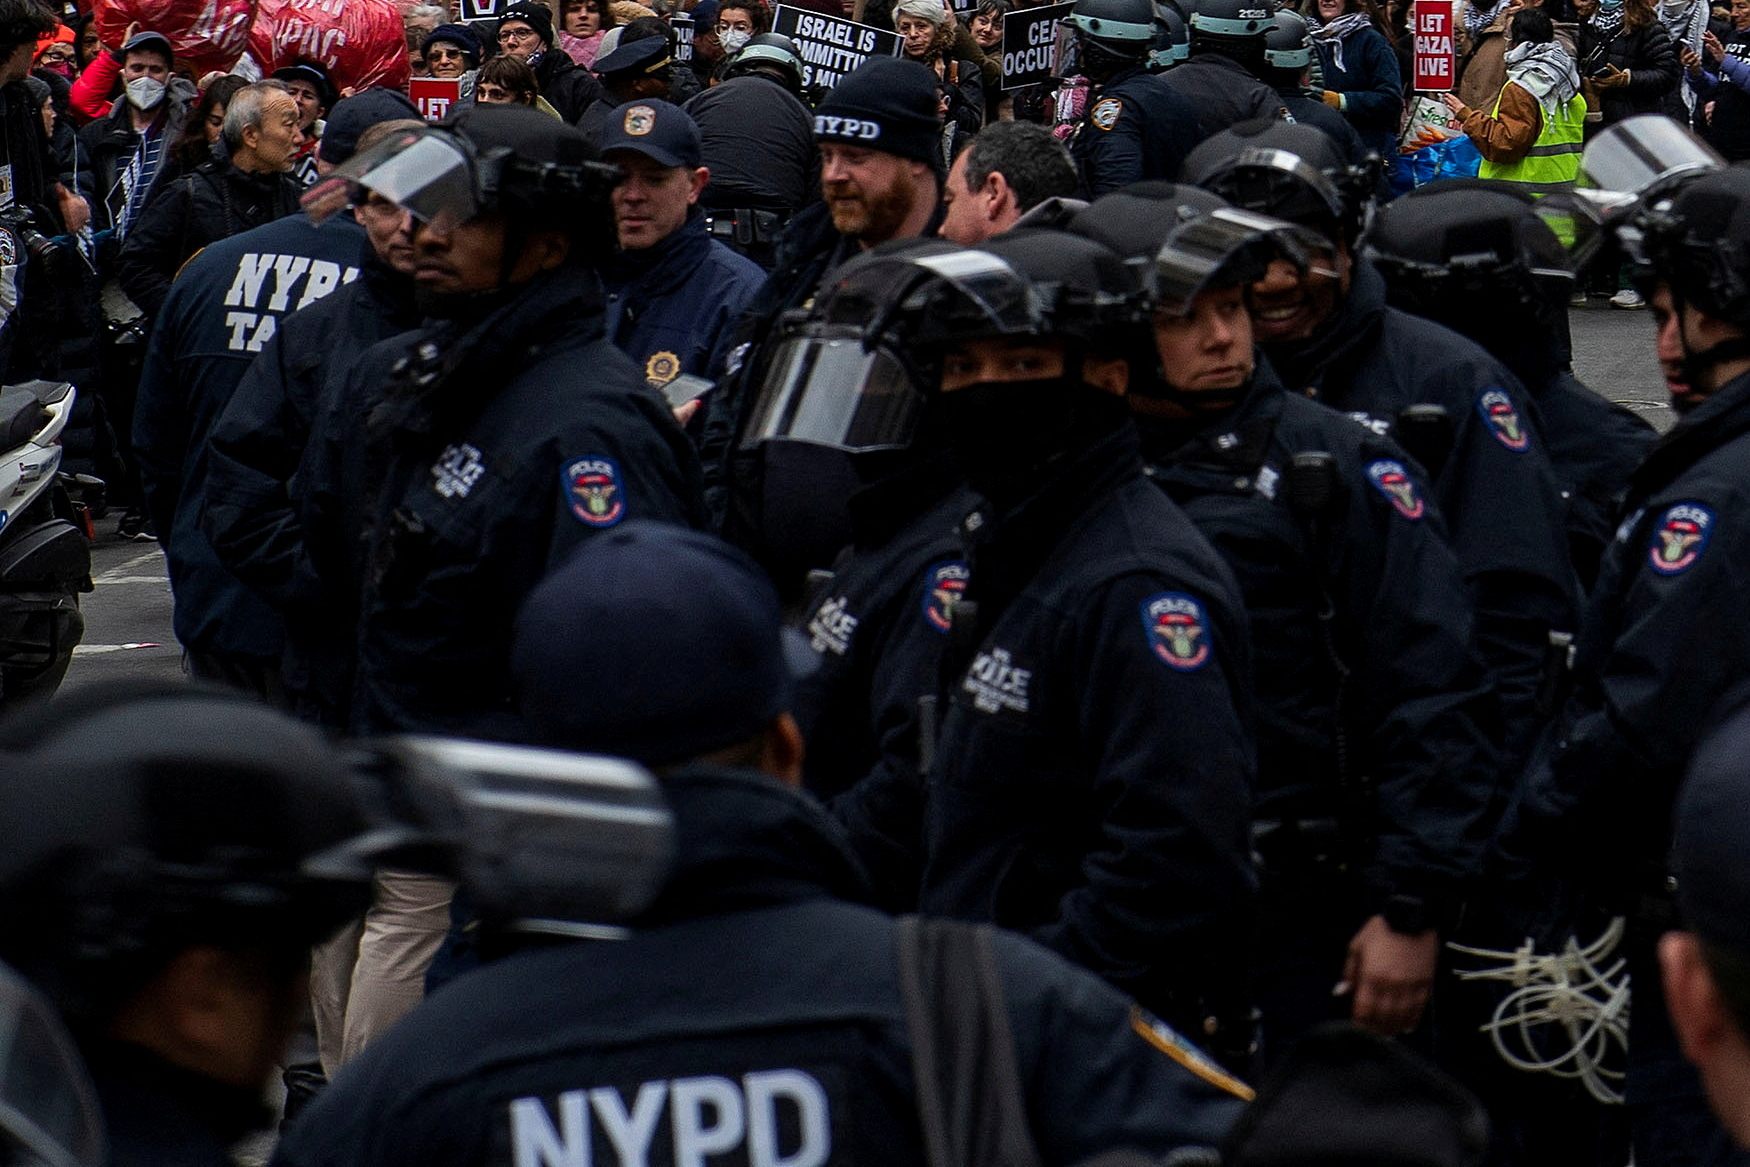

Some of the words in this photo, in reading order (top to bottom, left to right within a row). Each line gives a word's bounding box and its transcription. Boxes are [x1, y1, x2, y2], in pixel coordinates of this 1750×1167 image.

[795, 14, 855, 48] ISRAEL
[858, 29, 876, 52] IS
[1421, 14, 1446, 33] LET
[1416, 36, 1452, 54] GAZA
[1418, 58, 1449, 76] LIVE
[417, 97, 449, 120] LET
[223, 253, 360, 312] NYP
[509, 1067, 833, 1167] NYPD
